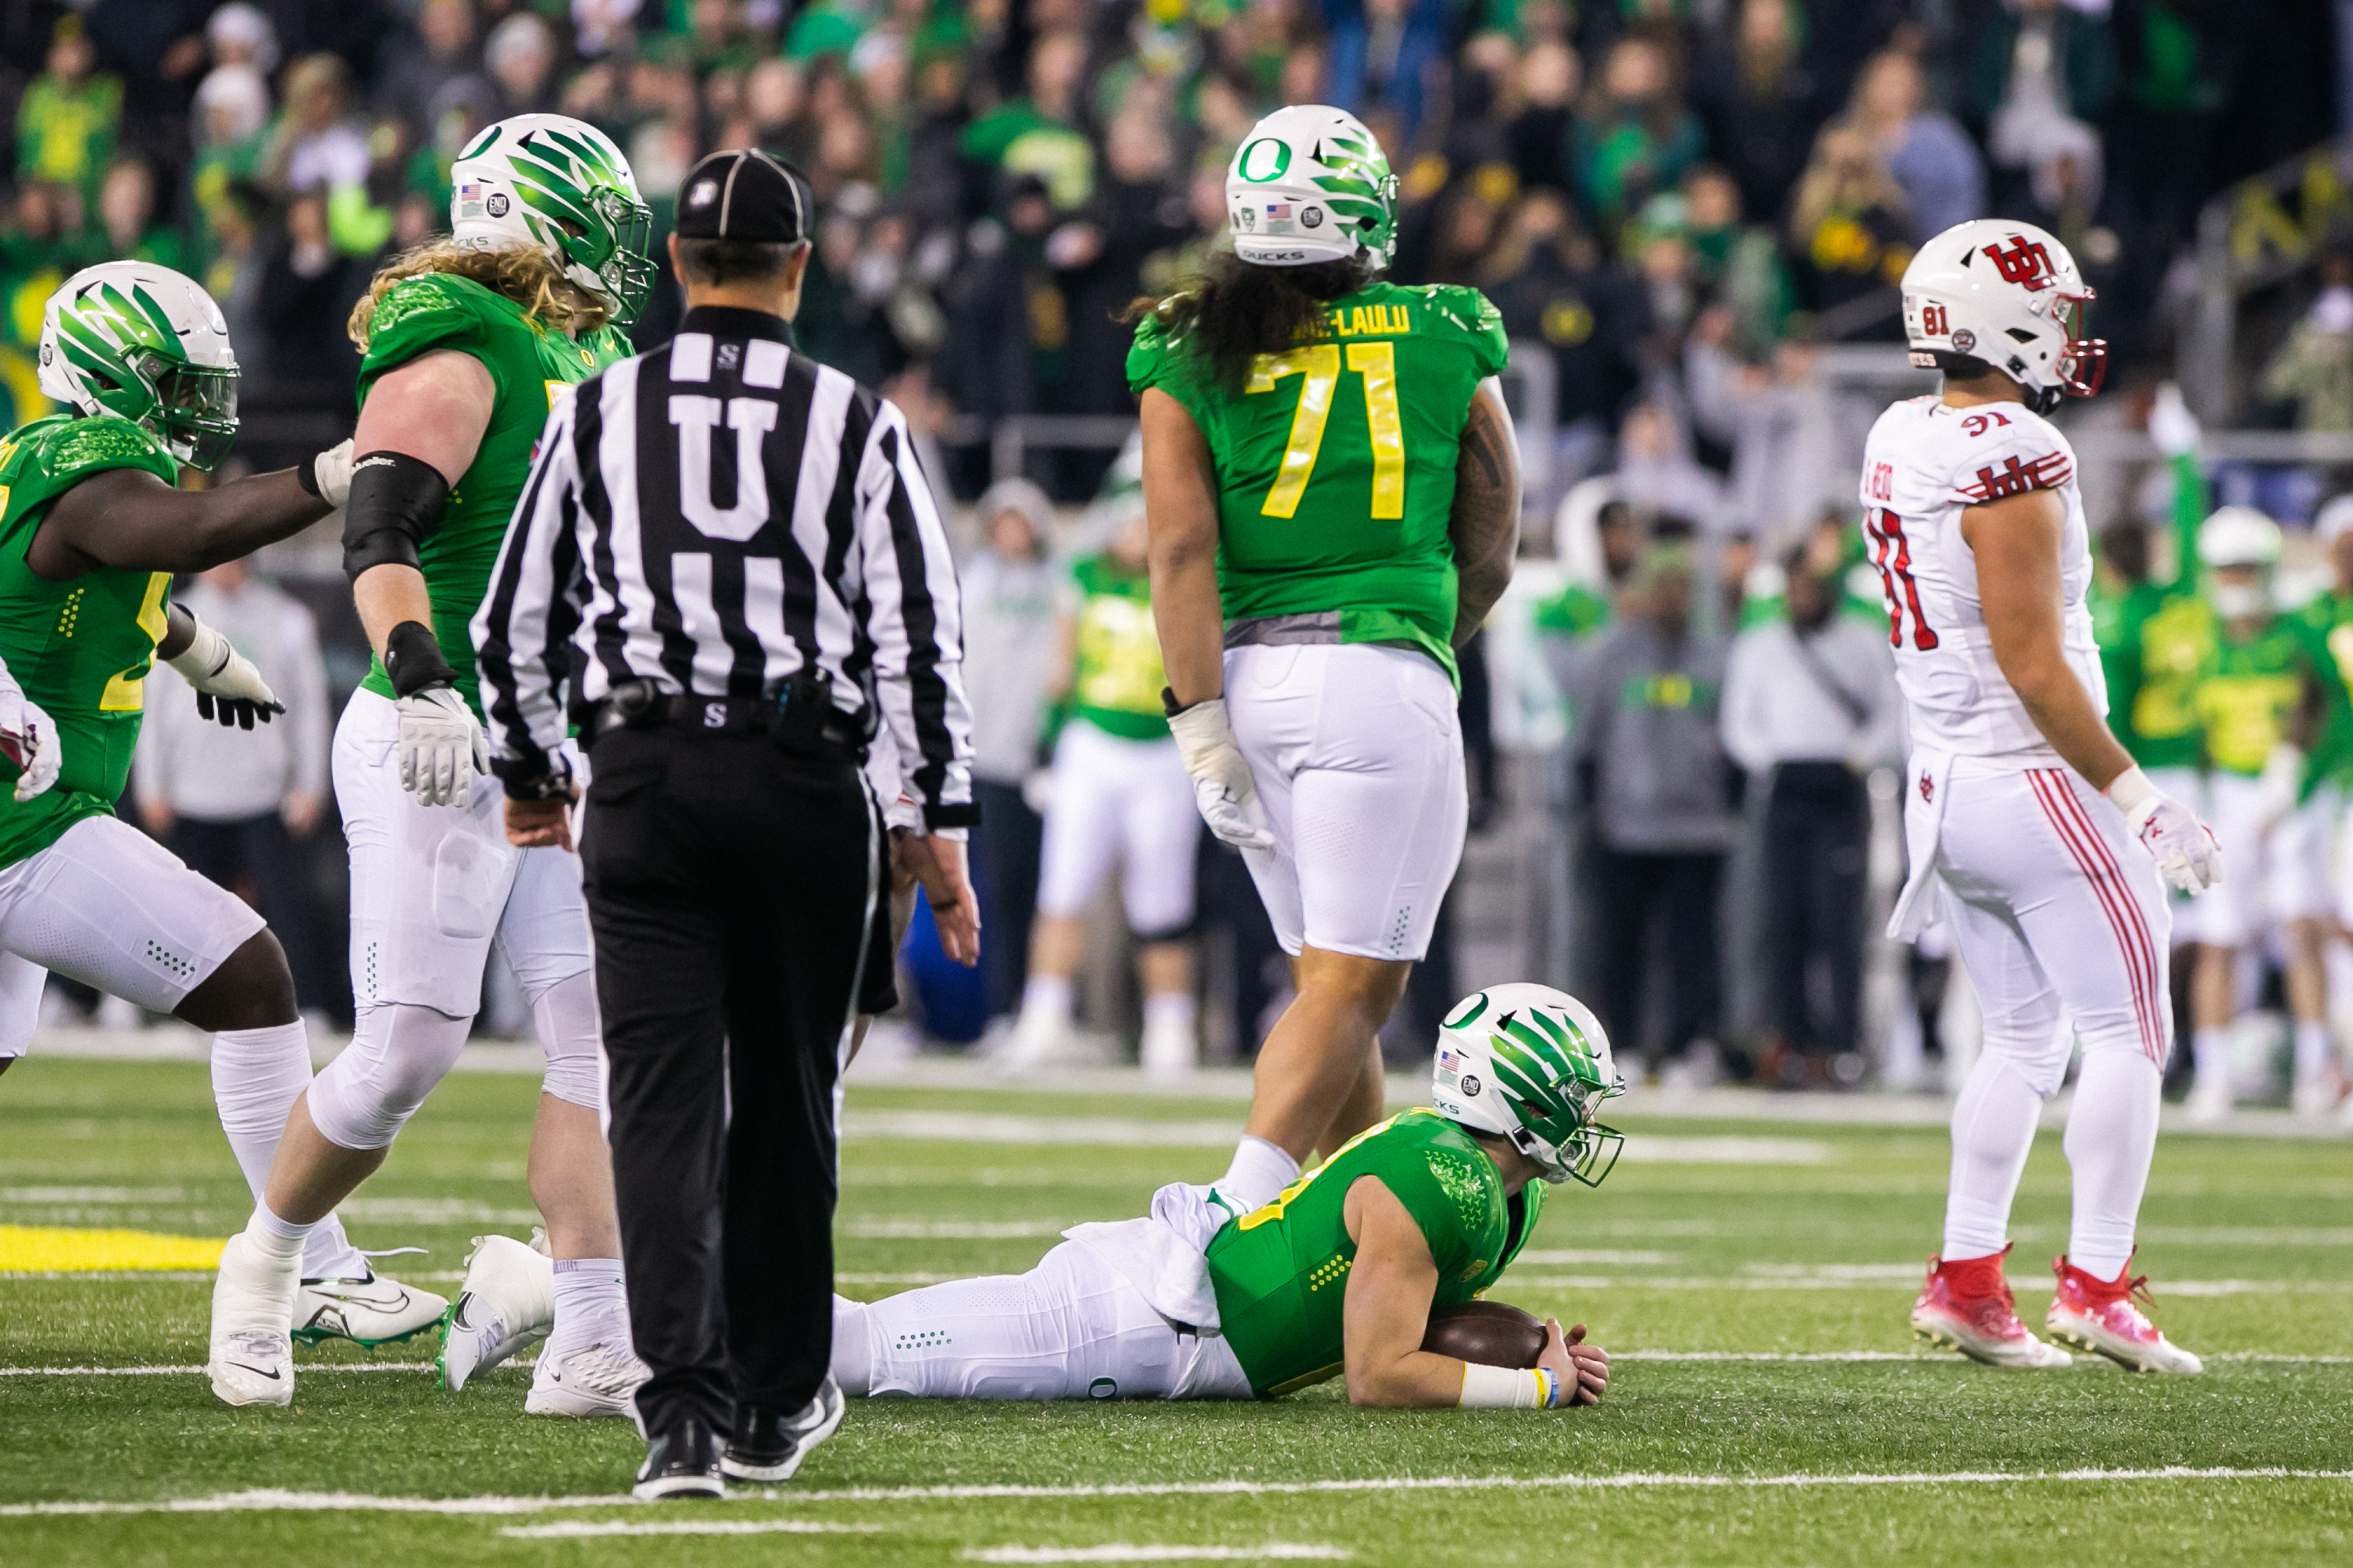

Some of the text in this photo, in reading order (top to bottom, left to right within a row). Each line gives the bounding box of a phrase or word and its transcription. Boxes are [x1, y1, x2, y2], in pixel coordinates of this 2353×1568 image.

[1239, 138, 1292, 183] O
[489, 196, 507, 208] END
[1244, 341, 1405, 520] 71
[1961, 412, 2012, 437] 91
[668, 395, 779, 541] U
[704, 703, 727, 728] S
[1464, 1077, 1479, 1089] END
